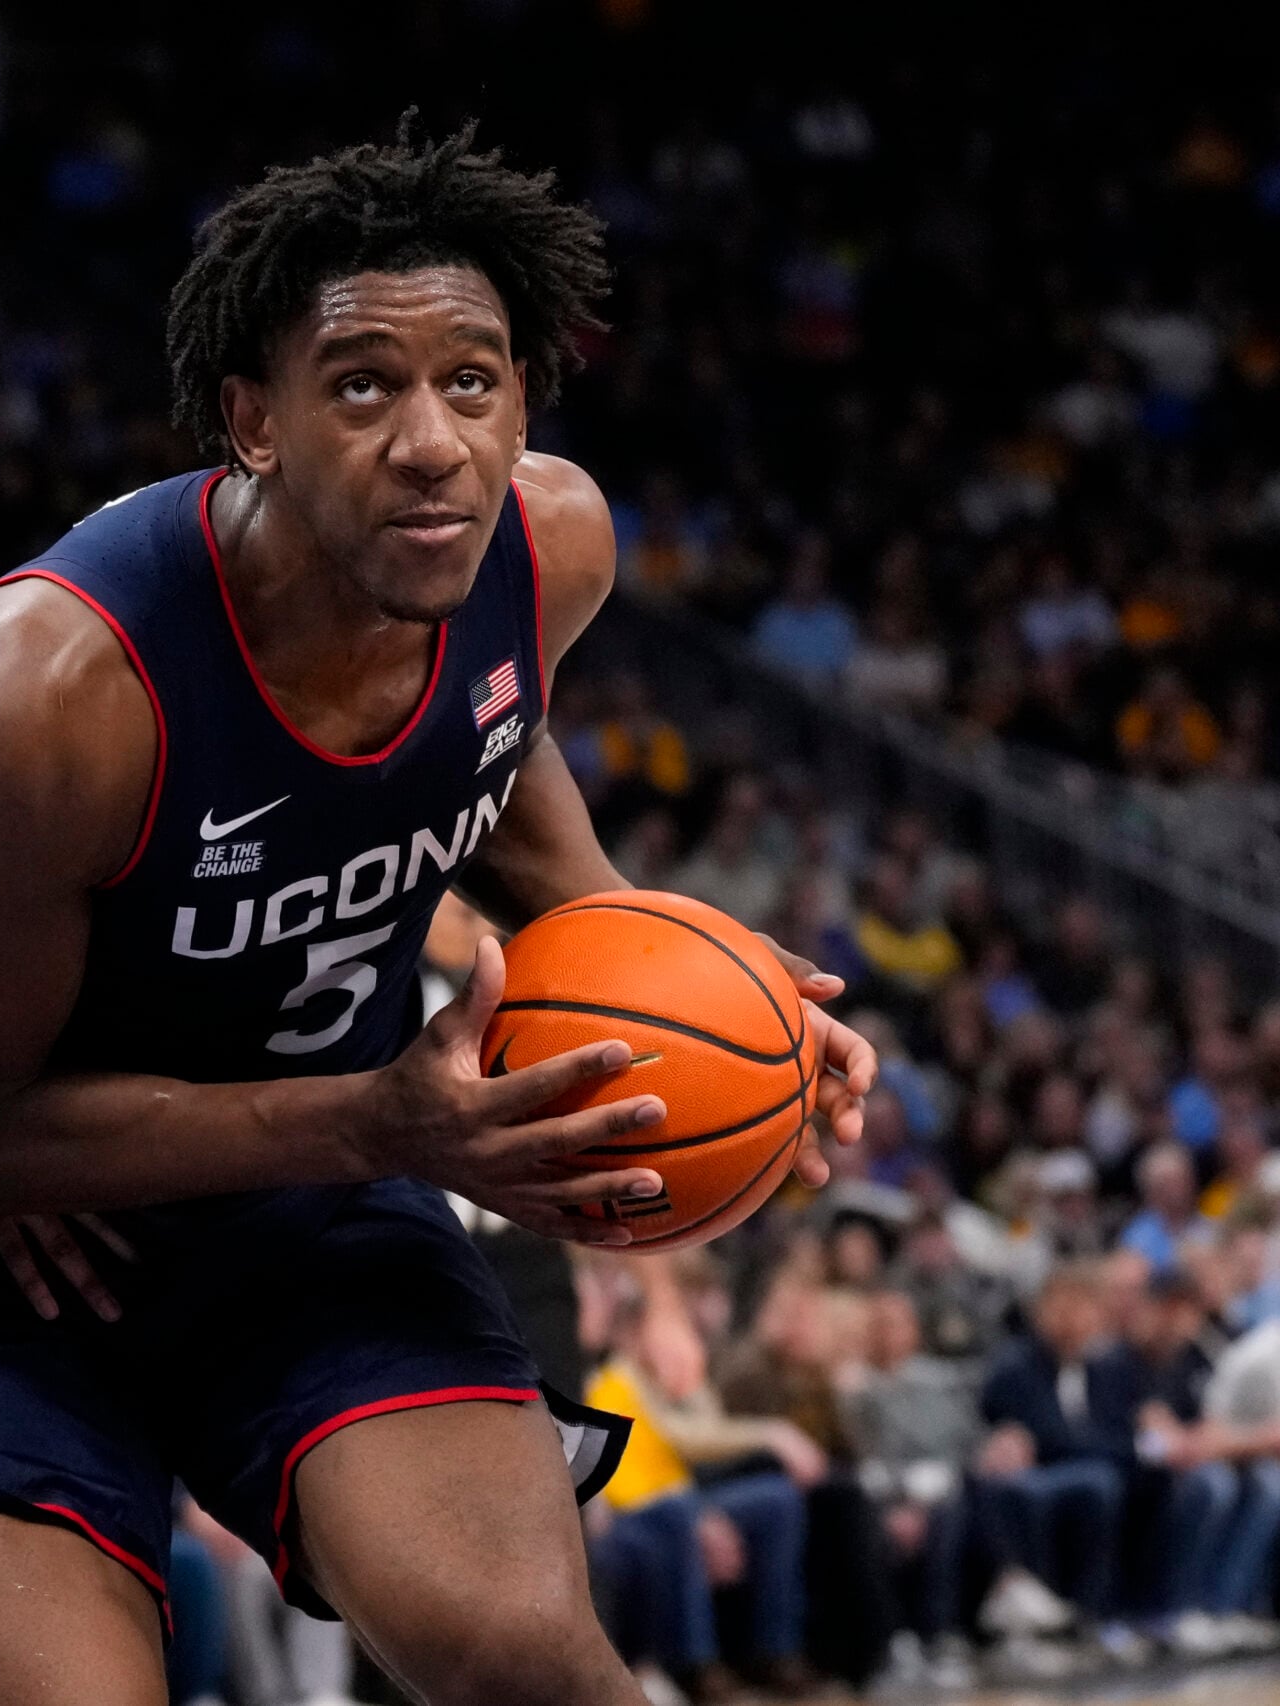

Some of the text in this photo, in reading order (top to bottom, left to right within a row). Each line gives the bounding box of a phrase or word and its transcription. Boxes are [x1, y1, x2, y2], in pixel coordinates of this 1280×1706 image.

[480, 722, 524, 765] EAST
[486, 713, 519, 750] BIG
[172, 768, 517, 960] UCONN
[193, 857, 264, 878] CHANGE
[202, 841, 264, 862] BE THE
[265, 921, 397, 1054] 5
